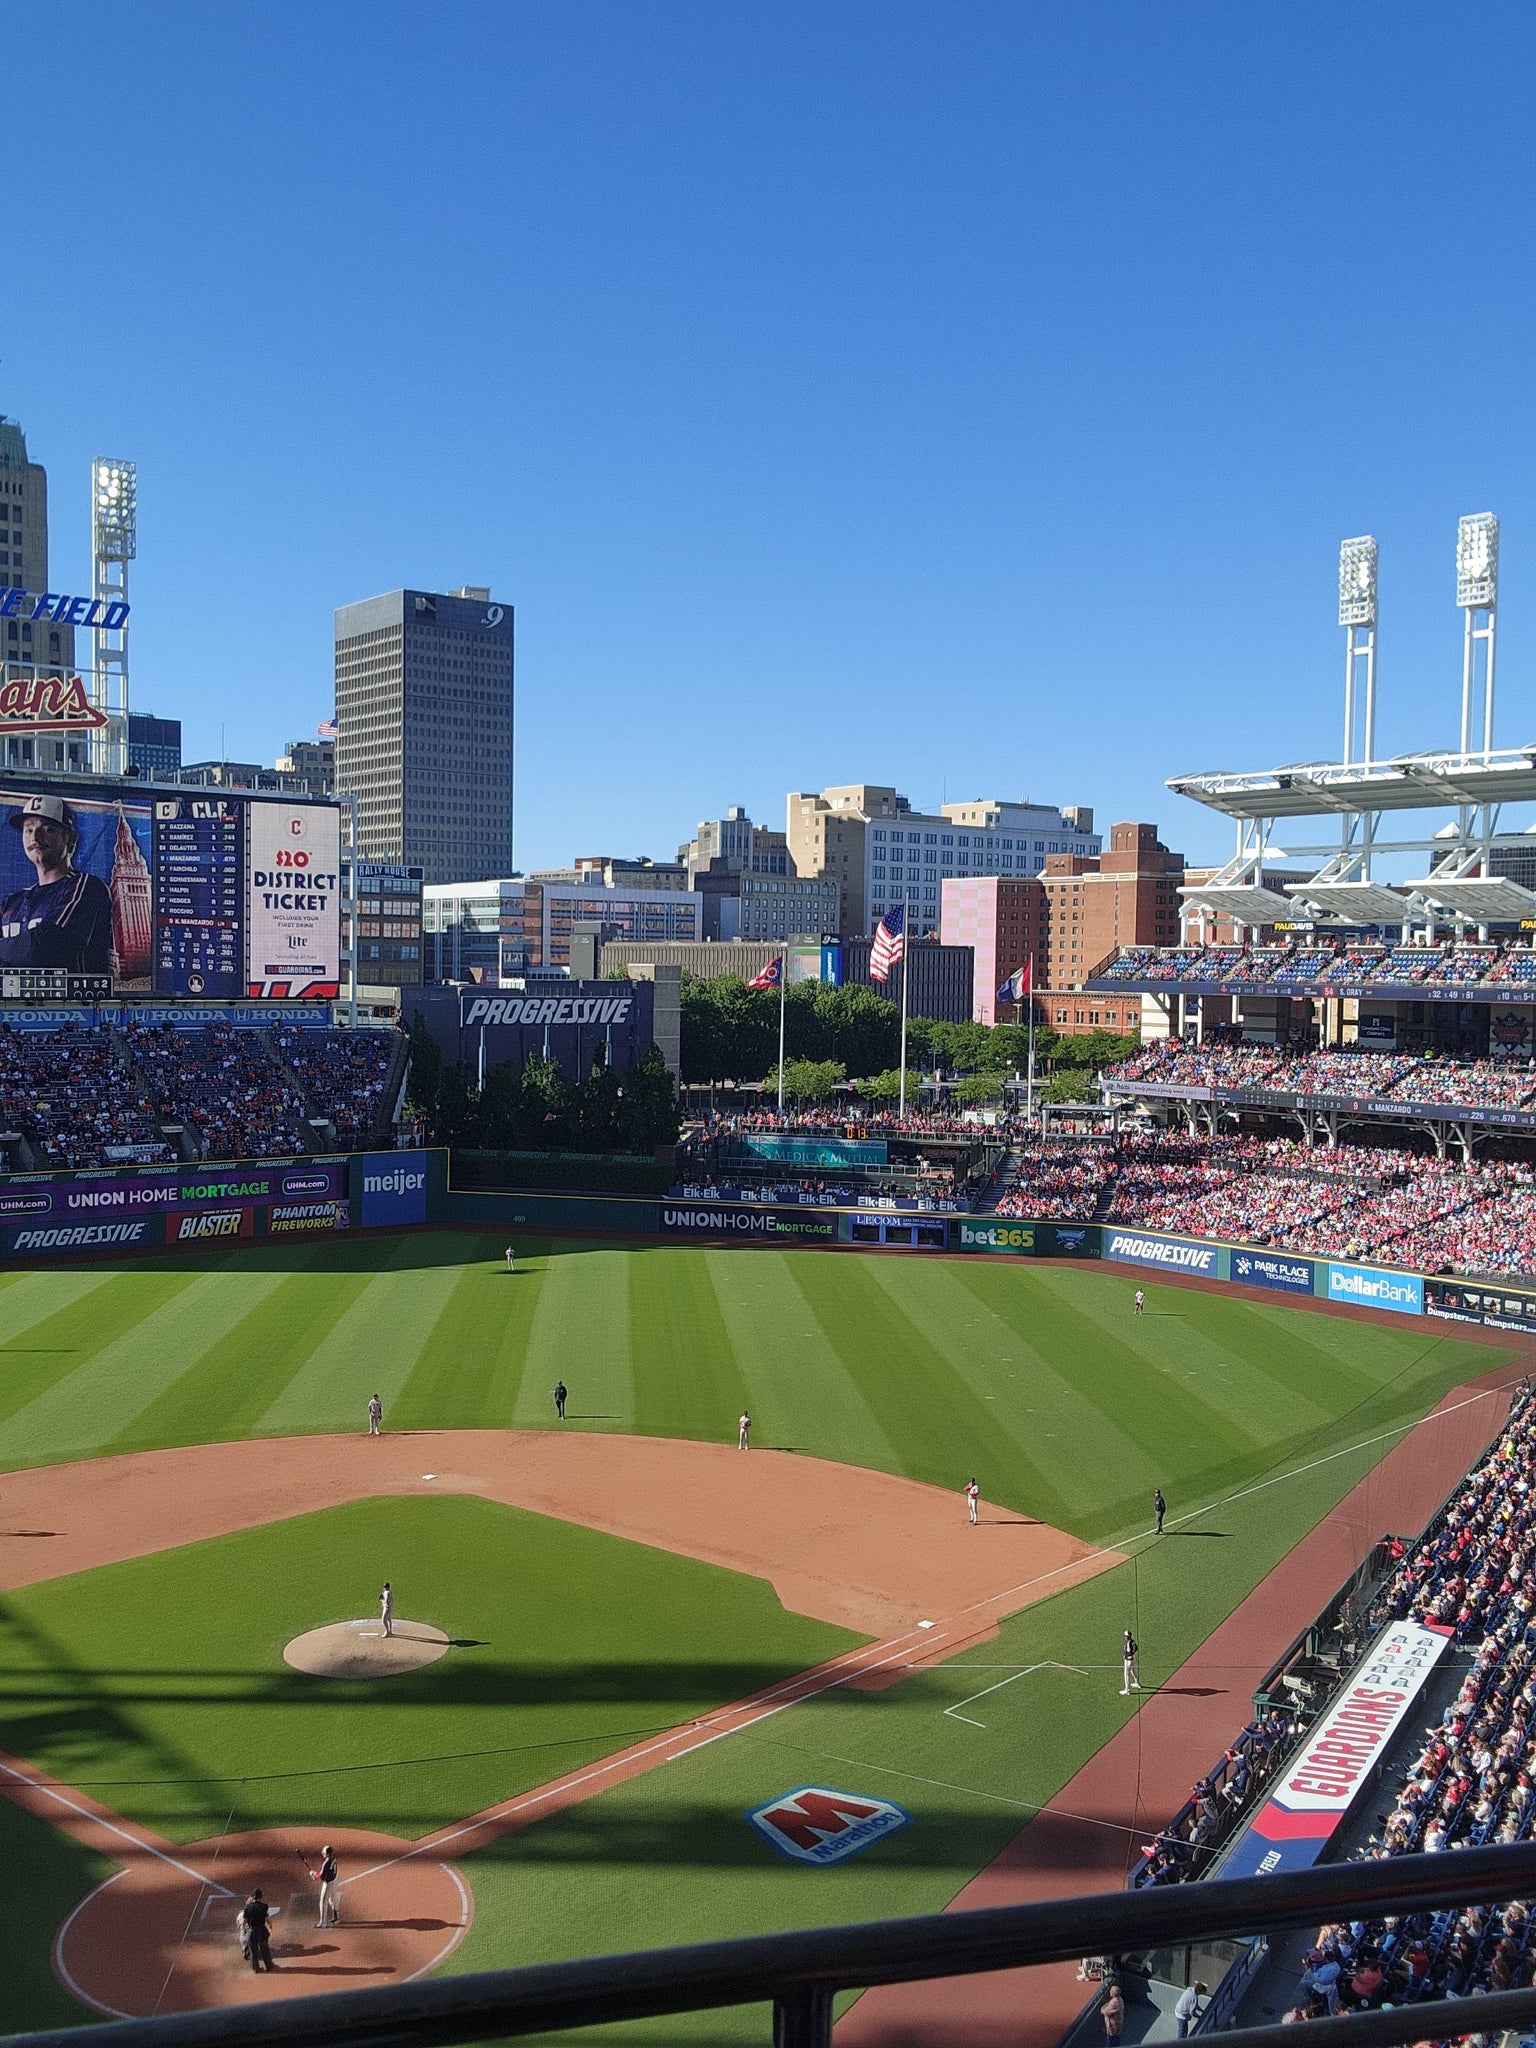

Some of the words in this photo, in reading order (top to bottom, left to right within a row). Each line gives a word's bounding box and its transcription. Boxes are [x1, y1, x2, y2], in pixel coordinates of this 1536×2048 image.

[31, 592, 130, 629] FIELD
[486, 606, 504, 629] 9
[162, 805, 169, 816] C
[291, 820, 301, 835] C
[360, 865, 382, 876] RALLY
[384, 867, 410, 879] HOUSE
[254, 871, 336, 890] DISTRICT
[263, 893, 327, 910] TICKET
[287, 935, 308, 949] Lite
[83, 980, 87, 988] 1
[101, 980, 108, 988] 2
[1325, 988, 1333, 996] 54
[1346, 989, 1363, 997] GRAY
[1449, 991, 1457, 999] 49
[1502, 992, 1509, 1000] 10
[2, 1011, 87, 1022] HONDA
[151, 1010, 227, 1021] HONDA
[251, 1009, 323, 1020] HONDA
[466, 999, 632, 1025] PROGRESSIVE
[1353, 1101, 1358, 1110] 9
[1375, 1104, 1411, 1114] MANZARDO
[1470, 1112, 1484, 1120] .226
[1500, 1114, 1516, 1122] .670
[1530, 1116, 1535, 1124] 5
[831, 1139, 857, 1147] Cleveland
[198, 1163, 238, 1171] PROGRESSIVE
[256, 1160, 295, 1168] PROGRESSIVE
[312, 1156, 349, 1165] PROGRESSIVE
[75, 1170, 118, 1179] PROGRESSIVE
[138, 1166, 180, 1175] PROGRESSIVE
[9, 1174, 54, 1183] PROGRESSIVE
[287, 1181, 325, 1189] UHM.com
[364, 1169, 424, 1195] meijer
[68, 1192, 125, 1207] UNION
[129, 1188, 178, 1203] HOME
[181, 1182, 269, 1199] MORTGAGE
[0, 1200, 46, 1209] UHM.com
[272, 1204, 336, 1220] PHANTOM
[178, 1214, 242, 1239] BLASTER
[271, 1217, 334, 1231] FIREWORKS
[776, 1223, 832, 1234] MORTGAGE
[14, 1223, 145, 1249] PROGRESSIVE
[961, 1225, 1033, 1247] bet365
[1110, 1236, 1213, 1269] PROGRESSIVE
[1254, 1260, 1278, 1274] PARK
[1279, 1265, 1309, 1278] PLACE
[1266, 1273, 1309, 1285] TECHNOLOGIES
[1427, 1307, 1480, 1323] Dumpsters.com
[1288, 1688, 1407, 1797] GUARDIANS
[811, 1812, 900, 1858] Marathon
[1260, 1850, 1282, 1872] FIELD
